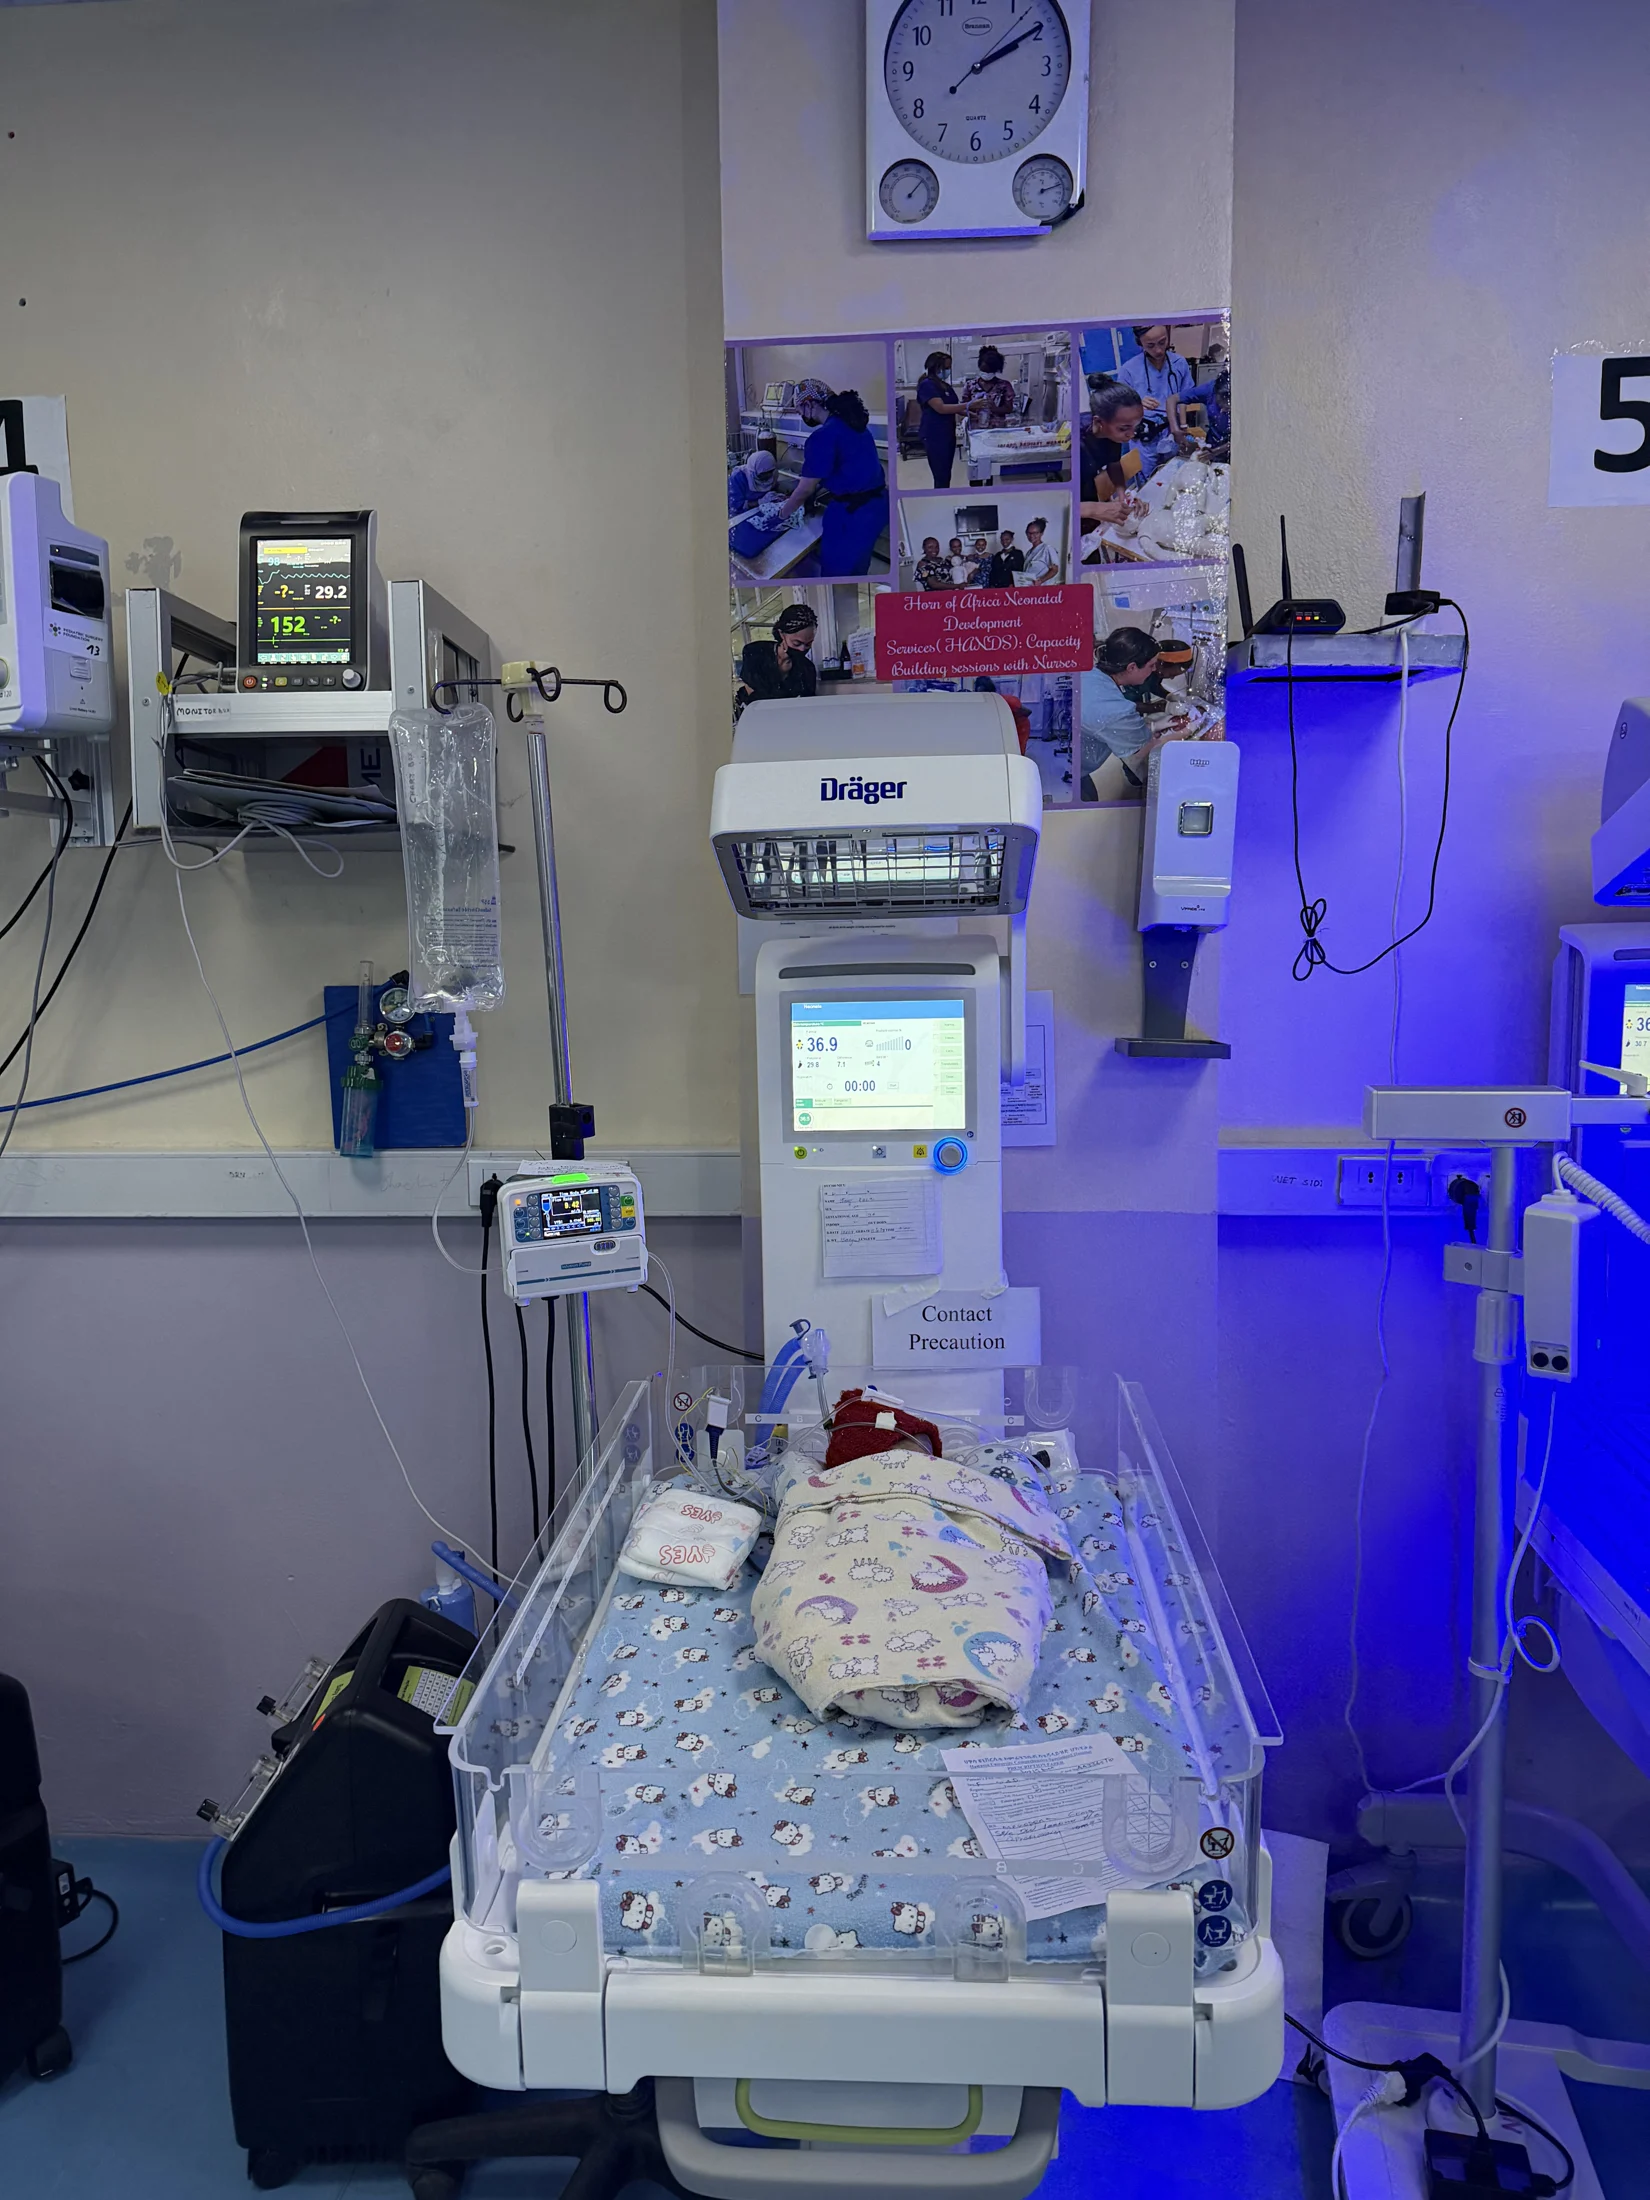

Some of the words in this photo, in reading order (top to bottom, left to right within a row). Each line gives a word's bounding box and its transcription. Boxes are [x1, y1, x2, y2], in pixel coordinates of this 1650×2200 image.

[912, 25, 932, 46] 10
[1032, 21, 1043, 41] 2
[903, 61, 914, 82] 9
[1041, 56, 1051, 76] 3
[913, 98, 924, 118] 8
[1029, 95, 1041, 114] 4
[937, 124, 948, 142] 7
[1003, 120, 1013, 140] 5
[970, 131, 981, 151] 6
[1594, 357, 1650, 473] 5
[268, 557, 280, 566] 98
[315, 585, 347, 599] 29.2
[904, 596, 941, 611] Horn
[945, 595, 957, 613] of
[960, 592, 1001, 611] Africa
[1003, 590, 1064, 607] Neonatal
[271, 616, 305, 633] 152
[943, 616, 1023, 633] Development
[87, 645, 100, 656] 13
[1026, 634, 1082, 651] Capacity
[891, 661, 948, 678] Building
[951, 661, 1000, 674] sessions
[1003, 658, 1030, 672] with
[1032, 655, 1078, 671] Nurses
[177, 708, 216, 716] MONITOR
[820, 776, 907, 804] Dräger
[1636, 1017, 1650, 1032] 36
[807, 1036, 838, 1052] 36.9
[905, 1039, 912, 1050] 0
[844, 1080, 876, 1092] 00:00
[922, 1305, 992, 1322] Contact
[909, 1333, 1005, 1350] Precaution
[659, 1545, 703, 1566] YES
